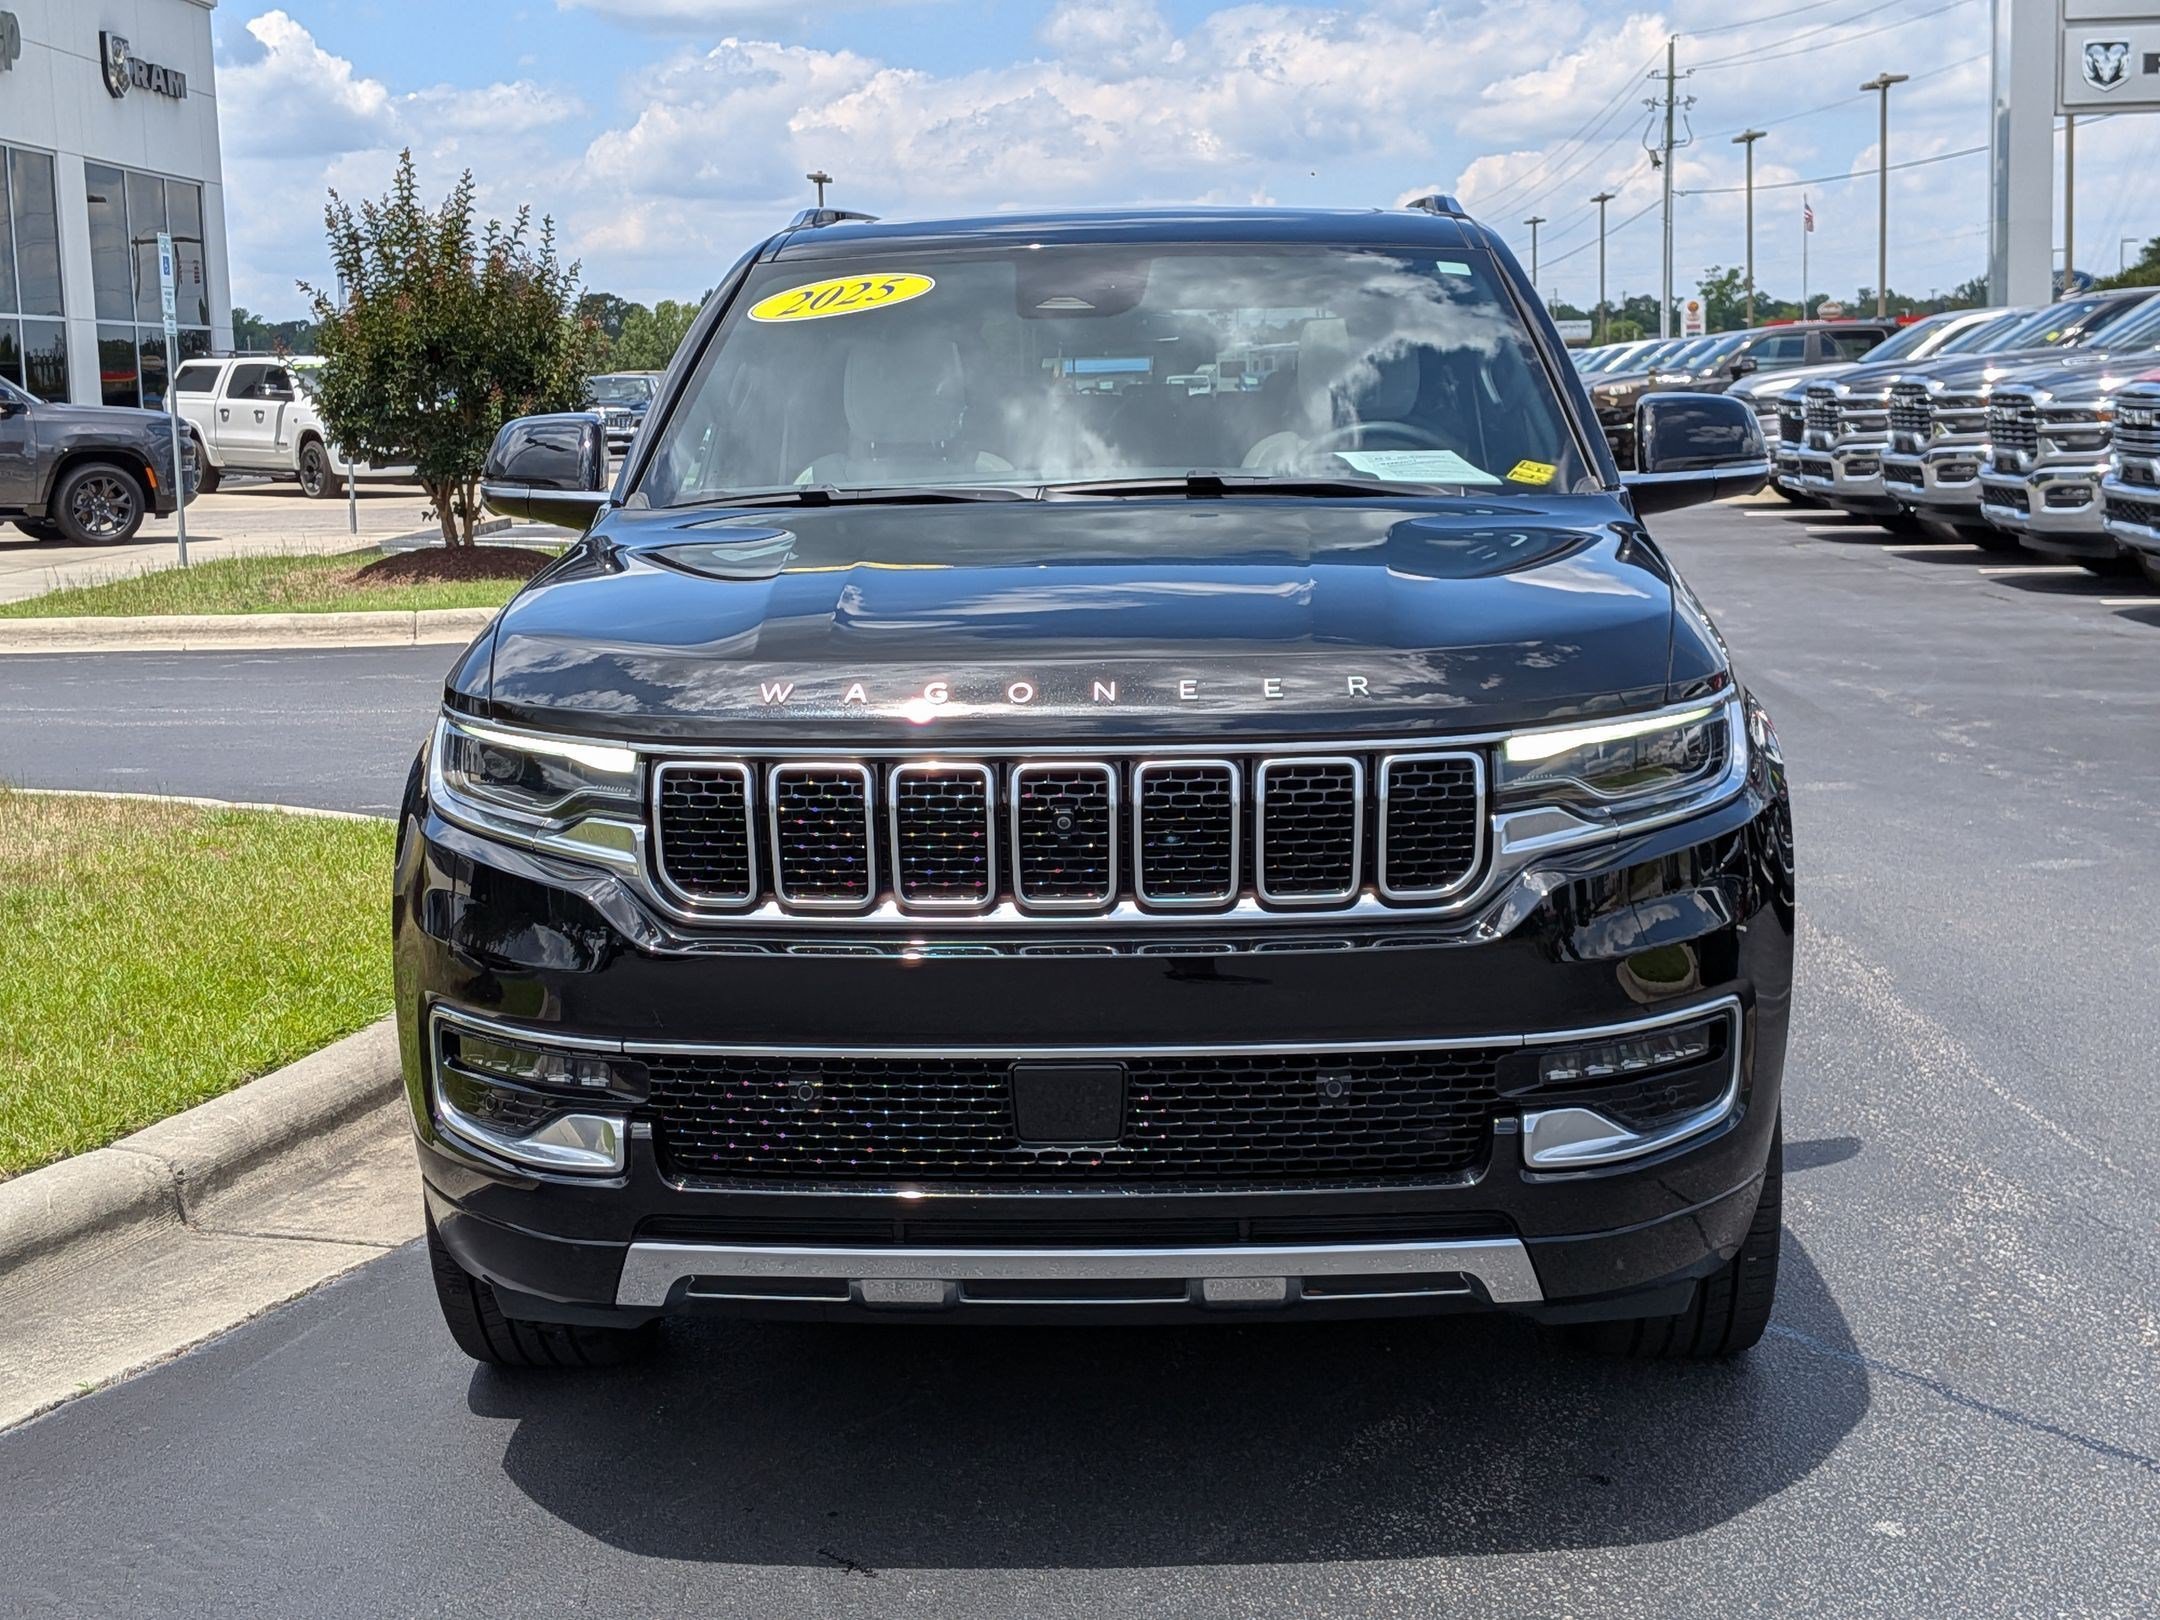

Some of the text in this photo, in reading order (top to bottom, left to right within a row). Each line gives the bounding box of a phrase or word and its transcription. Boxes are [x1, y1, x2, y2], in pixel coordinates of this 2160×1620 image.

[131, 58, 187, 99] RAM
[776, 278, 905, 317] 2025
[760, 675, 1370, 704] WAGONEER
